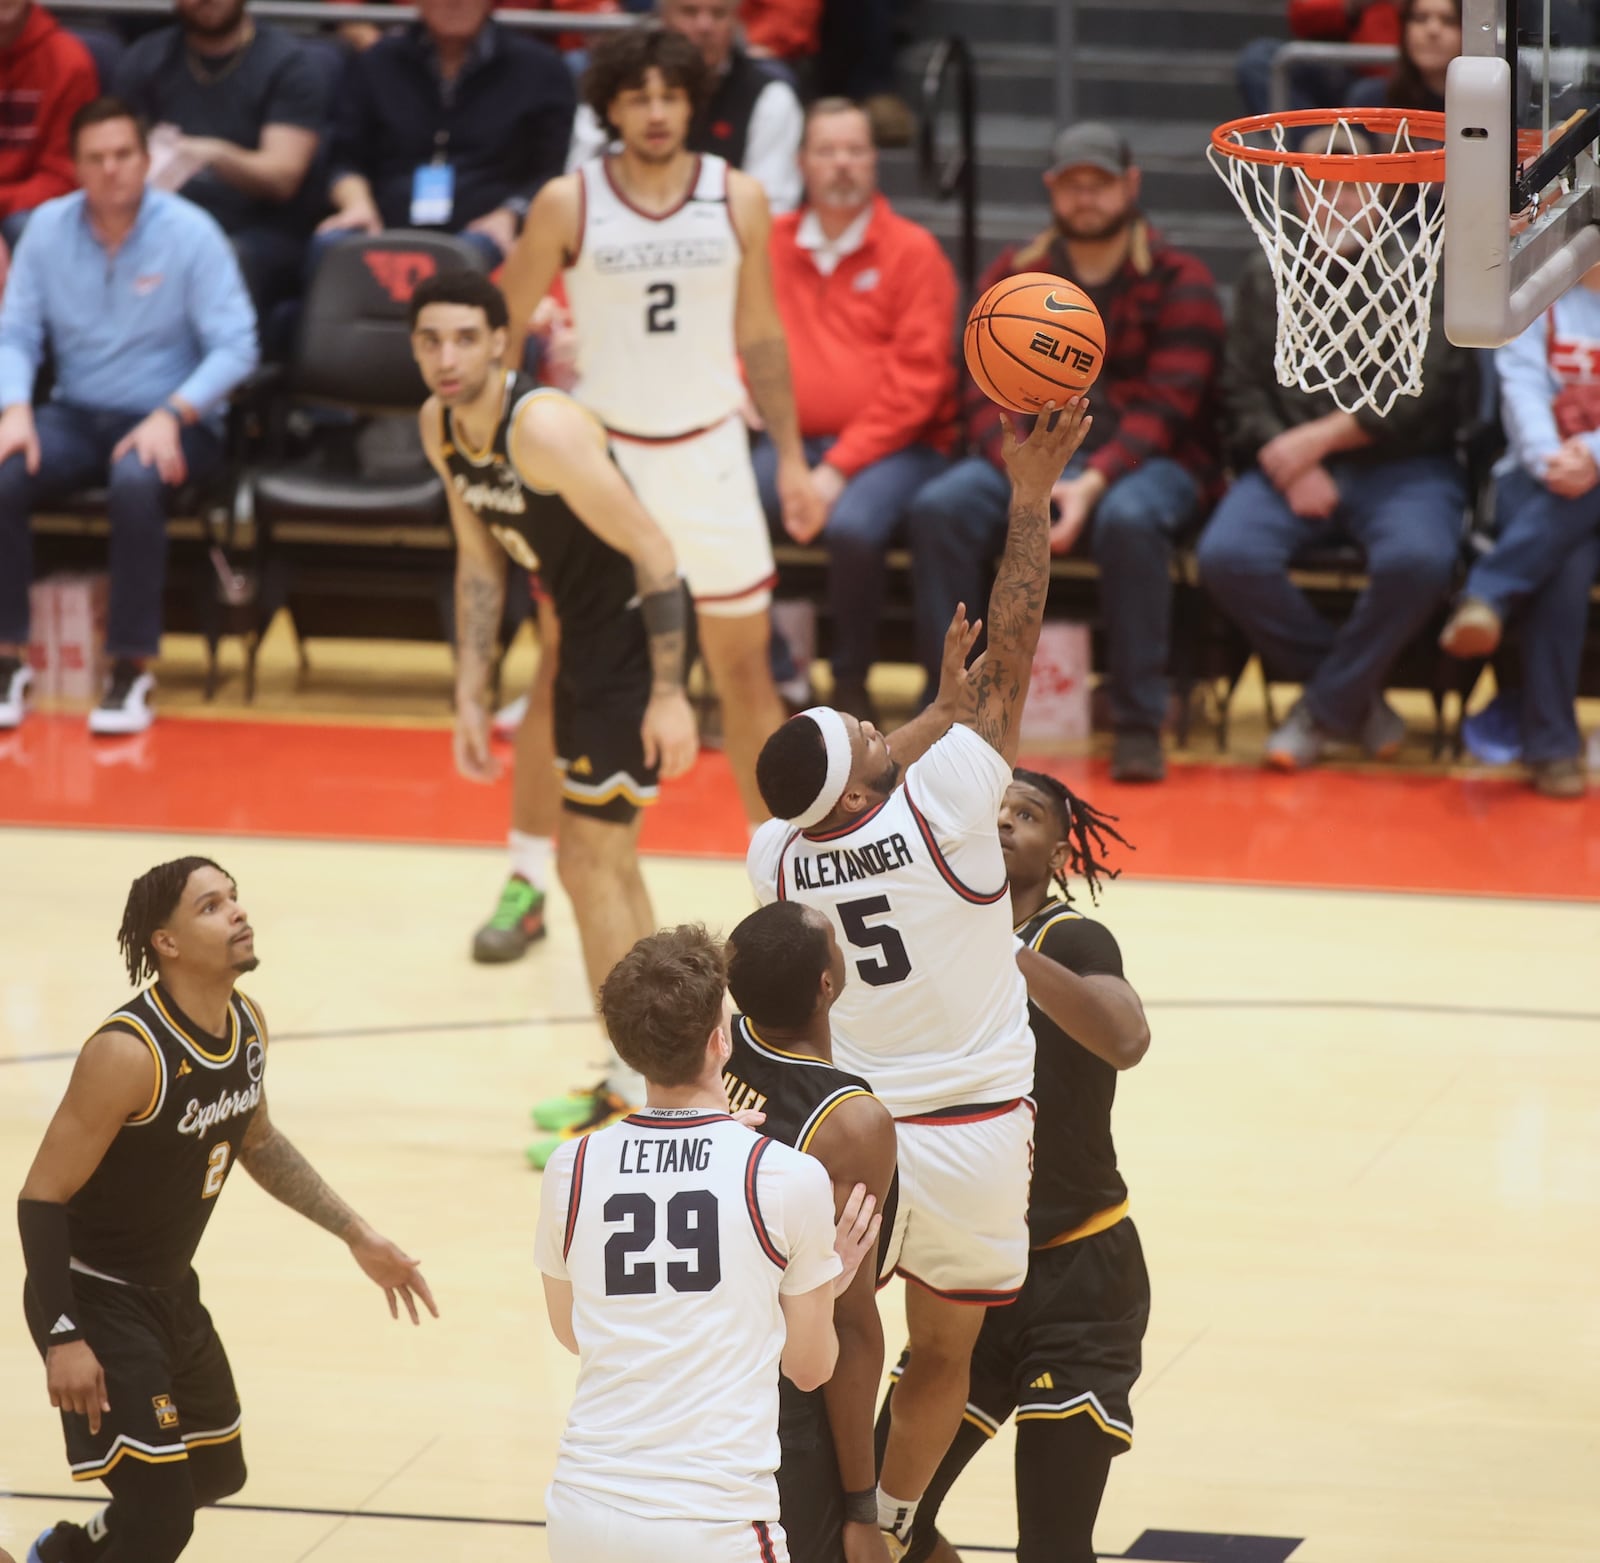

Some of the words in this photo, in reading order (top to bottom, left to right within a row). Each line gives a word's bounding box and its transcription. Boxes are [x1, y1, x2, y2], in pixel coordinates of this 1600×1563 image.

[646, 283, 676, 332] 2
[1029, 331, 1095, 373] ELITE
[794, 832, 913, 890] ALEXANDER
[836, 894, 912, 987] 5
[177, 1081, 263, 1139] Explorers
[202, 1141, 231, 1199] 2
[619, 1138, 713, 1174] L'ETANG
[604, 1190, 721, 1296] 29
